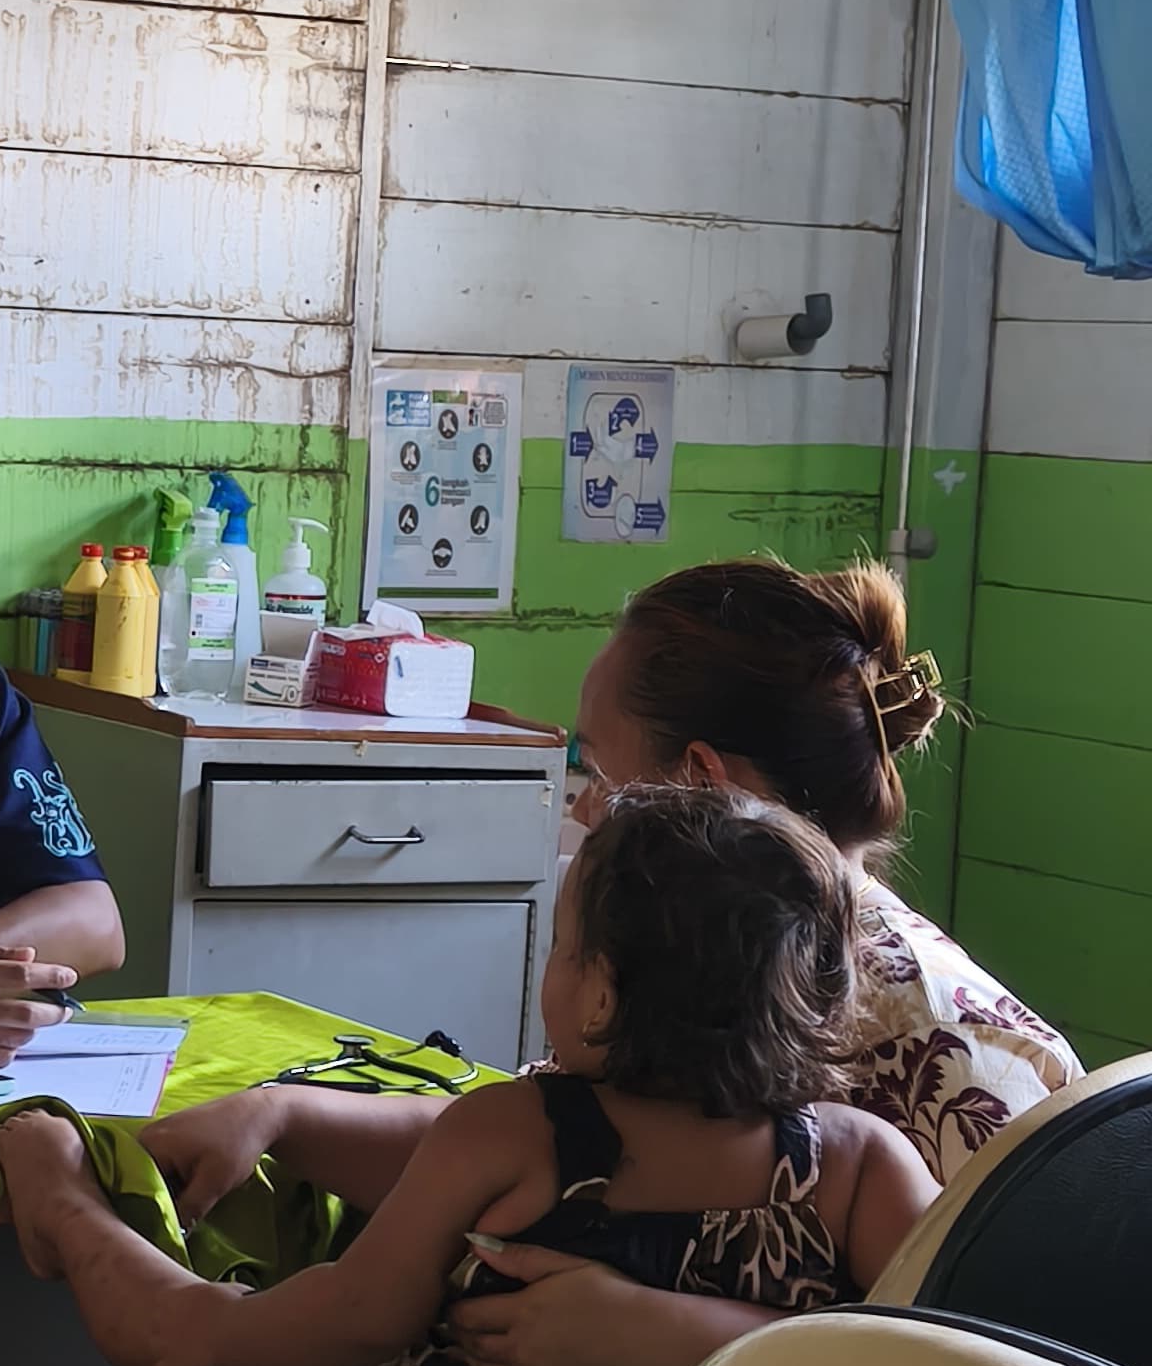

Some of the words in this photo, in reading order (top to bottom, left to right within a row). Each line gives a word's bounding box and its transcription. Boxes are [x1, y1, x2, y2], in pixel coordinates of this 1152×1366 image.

[612, 413, 619, 430] 2
[572, 436, 577, 453] 1
[425, 476, 440, 507] 6
[588, 482, 595, 498] 3
[636, 508, 643, 524] 5
